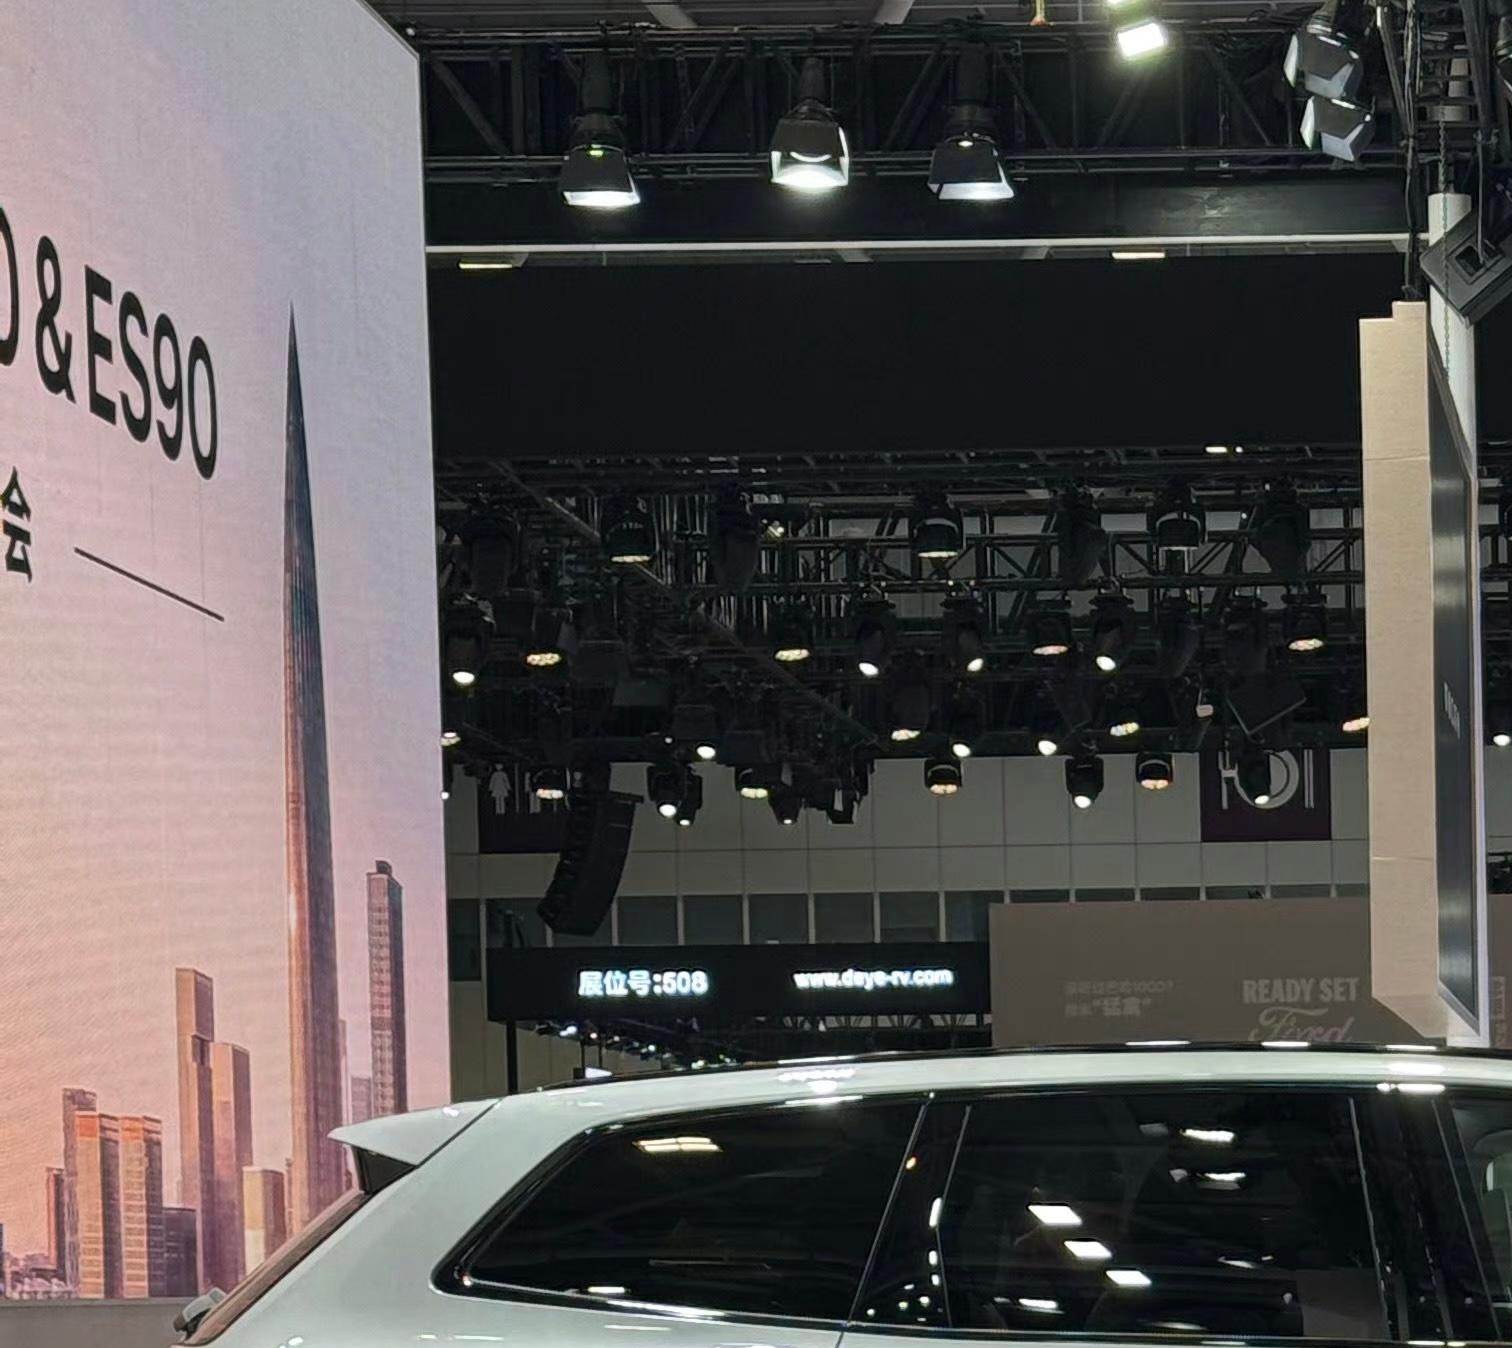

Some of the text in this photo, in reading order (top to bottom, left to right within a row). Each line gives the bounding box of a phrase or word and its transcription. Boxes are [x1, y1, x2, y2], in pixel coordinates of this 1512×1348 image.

[35, 235, 76, 404] &
[84, 263, 219, 482] ES90
[578, 969, 709, 997] 展位号:508
[1243, 977, 1360, 1004] READY SET
